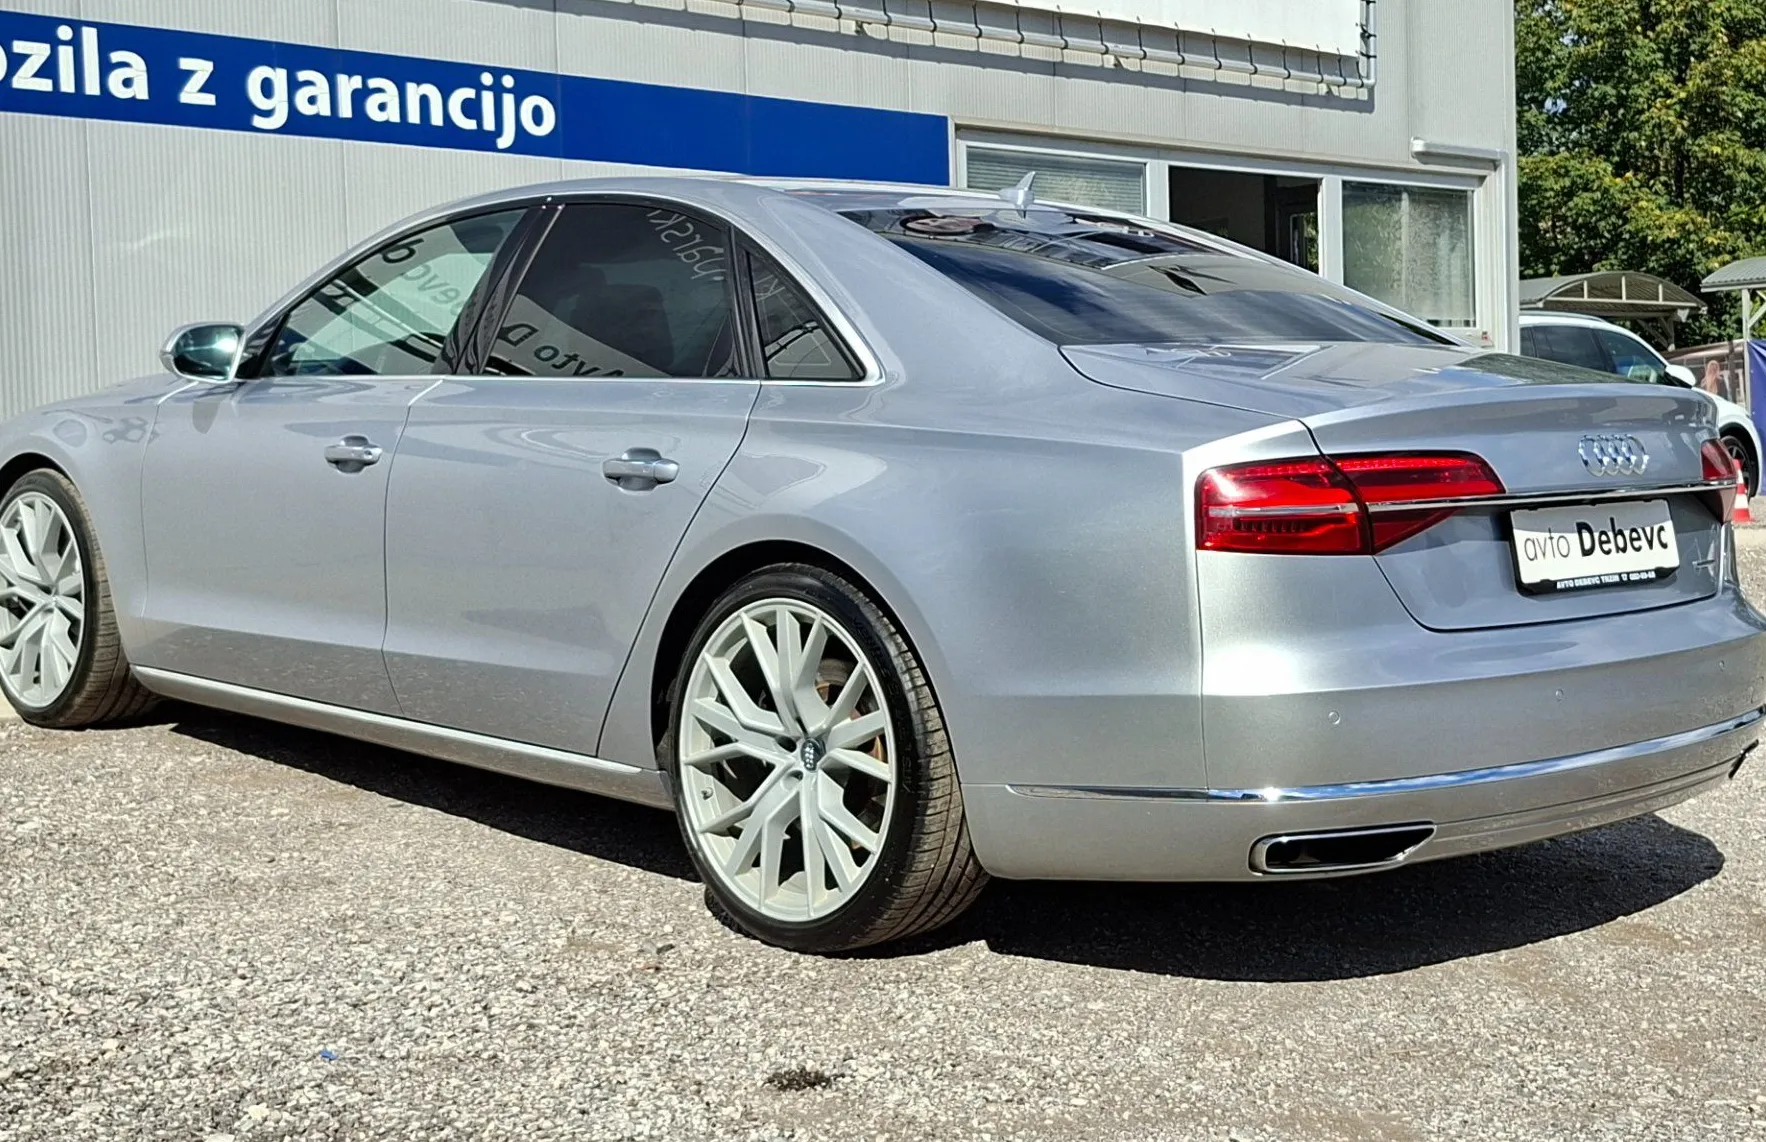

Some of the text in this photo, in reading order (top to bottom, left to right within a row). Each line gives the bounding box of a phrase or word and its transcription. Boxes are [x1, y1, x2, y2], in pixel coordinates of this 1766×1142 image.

[0, 25, 556, 149] zila z garancijo
[1524, 517, 1668, 561] avto Debevc
[1556, 580, 1574, 589] AVTO
[1574, 576, 1600, 587] DEBEVC
